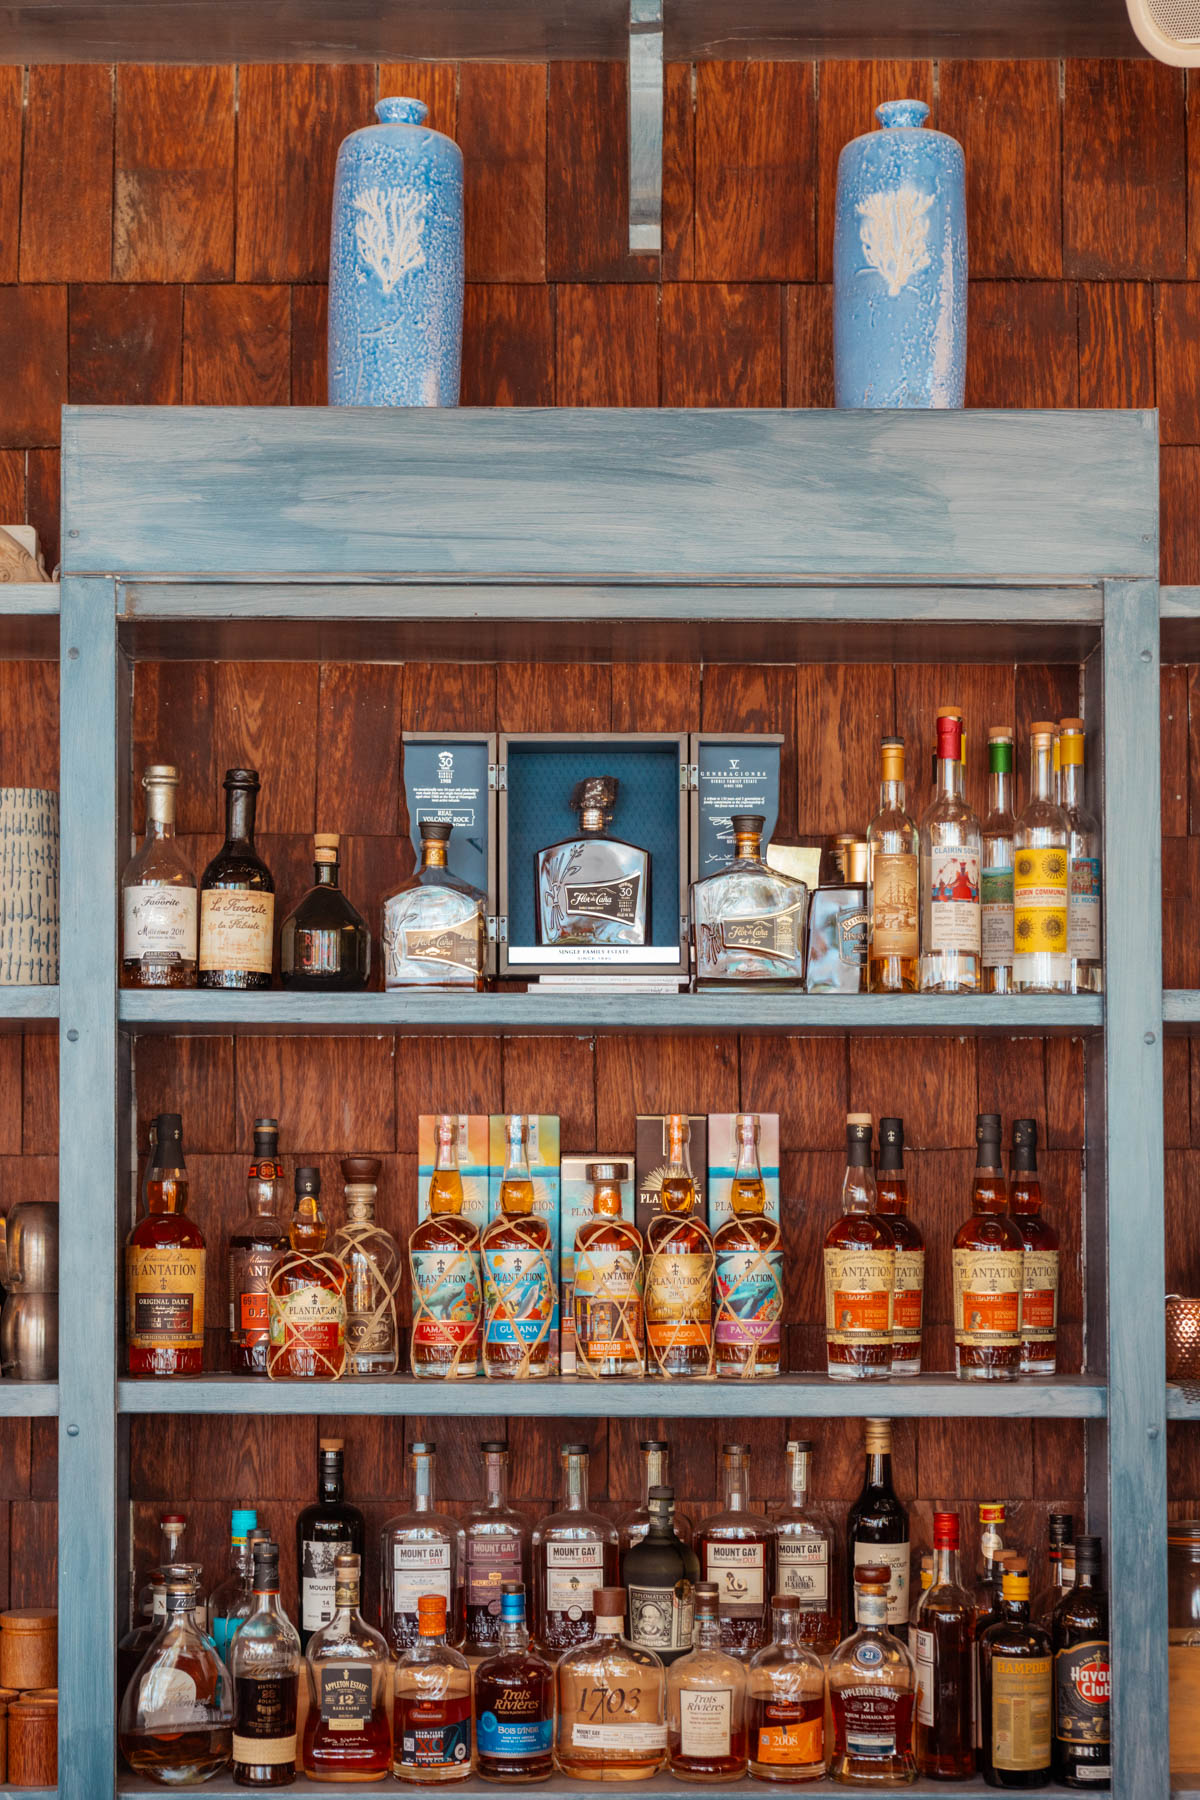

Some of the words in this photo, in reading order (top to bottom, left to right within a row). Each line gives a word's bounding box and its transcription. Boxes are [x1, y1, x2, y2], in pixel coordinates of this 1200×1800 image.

[438, 758, 453, 767] 30
[729, 760, 740, 769] V
[619, 887, 632, 897] 30
[1034, 888, 1067, 896] COMMUNAL
[140, 895, 181, 907] Favorite
[570, 892, 590, 905] Flor
[595, 892, 613, 906] Caña
[210, 897, 221, 911] La
[223, 898, 268, 915] Favorite
[728, 925, 746, 939] Flor
[752, 925, 769, 939] Caña
[830, 1266, 892, 1278] PLANTATION
[959, 1267, 1022, 1279] PLANTATION
[351, 1326, 367, 1336] XO
[499, 1325, 538, 1333] GUANA
[730, 1325, 768, 1335] PAAMA
[473, 1543, 499, 1552] MOUNT
[500, 1543, 516, 1552] GAY
[553, 1547, 580, 1556] MOUNT
[581, 1547, 596, 1556] GAY
[713, 1547, 740, 1557] MOUNT
[742, 1547, 757, 1557] GAY
[779, 1545, 806, 1554] MOUNT
[807, 1545, 822, 1554] GAY
[400, 1549, 427, 1558] MOUNT
[428, 1548, 444, 1558] GAY
[864, 1650, 874, 1659] 21
[1070, 1666, 1111, 1682] Hava
[324, 1680, 350, 1692] APPLETON
[350, 1680, 368, 1692] ESTATE
[502, 1689, 531, 1700] Trois
[694, 1694, 718, 1703] Trois
[840, 1687, 874, 1701] APPLETON
[338, 1695, 355, 1705] 12
[576, 1687, 642, 1721] 1703
[862, 1702, 875, 1713] 21
[415, 1738, 444, 1753] XO
[772, 1735, 799, 1746] 2008
